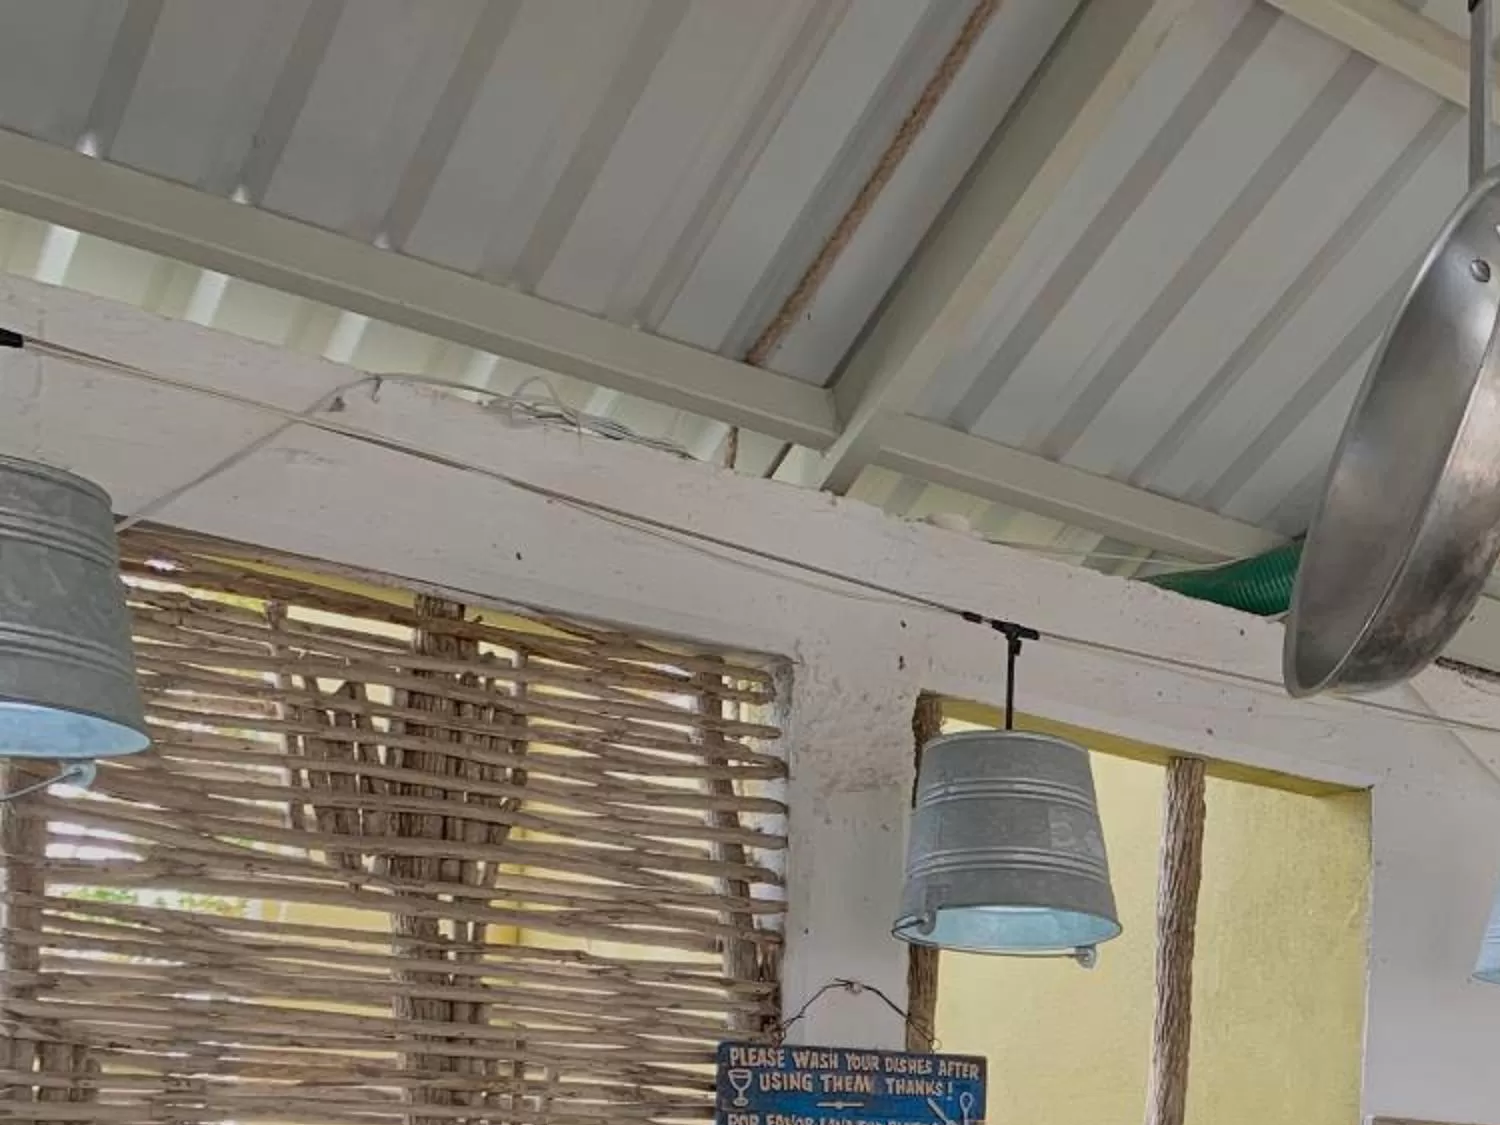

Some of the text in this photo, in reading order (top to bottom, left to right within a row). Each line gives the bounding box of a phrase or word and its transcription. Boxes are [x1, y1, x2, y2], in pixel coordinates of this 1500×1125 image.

[729, 1047, 979, 1080] PLEASE WASH YOUR DISHES AFTER
[759, 1072, 813, 1093] USING
[821, 1074, 871, 1093] THEM
